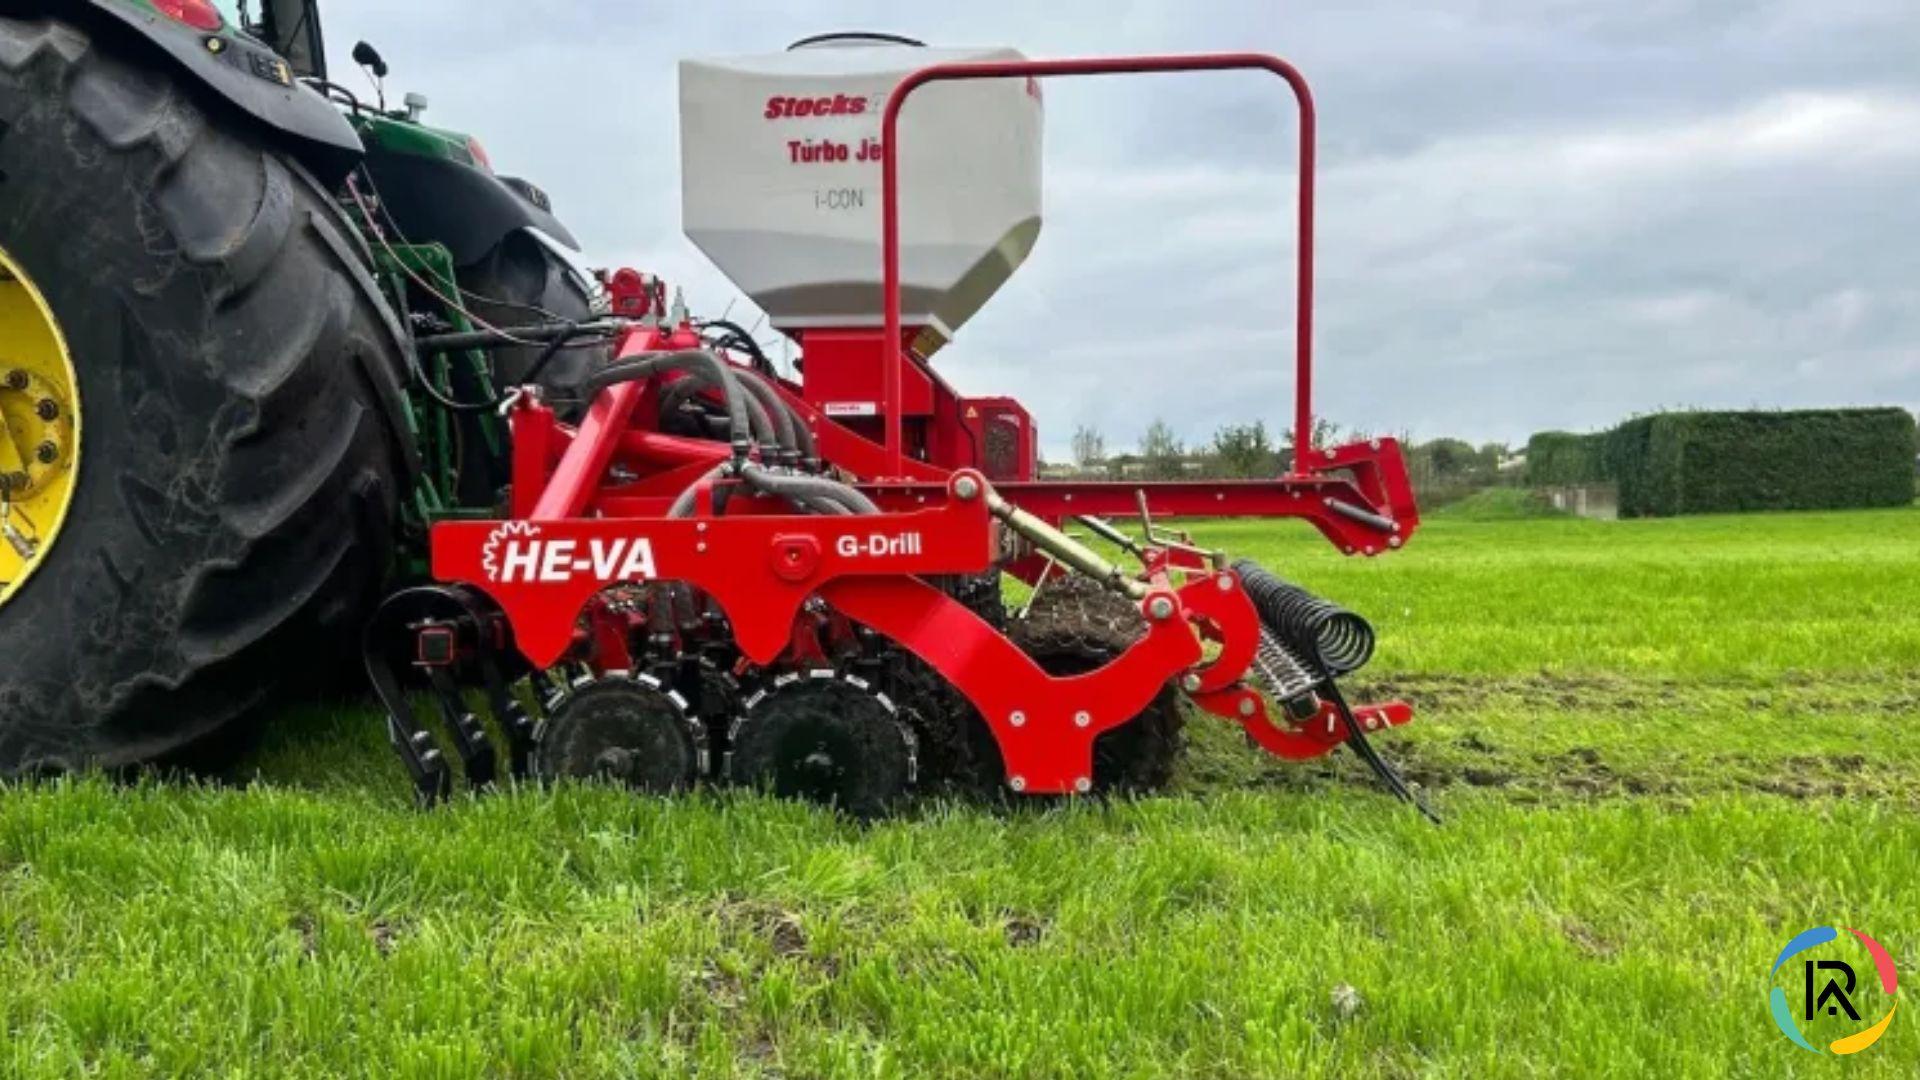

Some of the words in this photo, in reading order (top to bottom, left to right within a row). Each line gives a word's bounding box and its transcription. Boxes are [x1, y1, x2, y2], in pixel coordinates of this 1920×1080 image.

[764, 94, 867, 119] Stocks
[787, 139, 848, 162] Turbo
[856, 139, 882, 161] Je
[814, 188, 864, 209] i-CON
[837, 532, 922, 557] G-Drill
[501, 538, 657, 582] HE-VA
